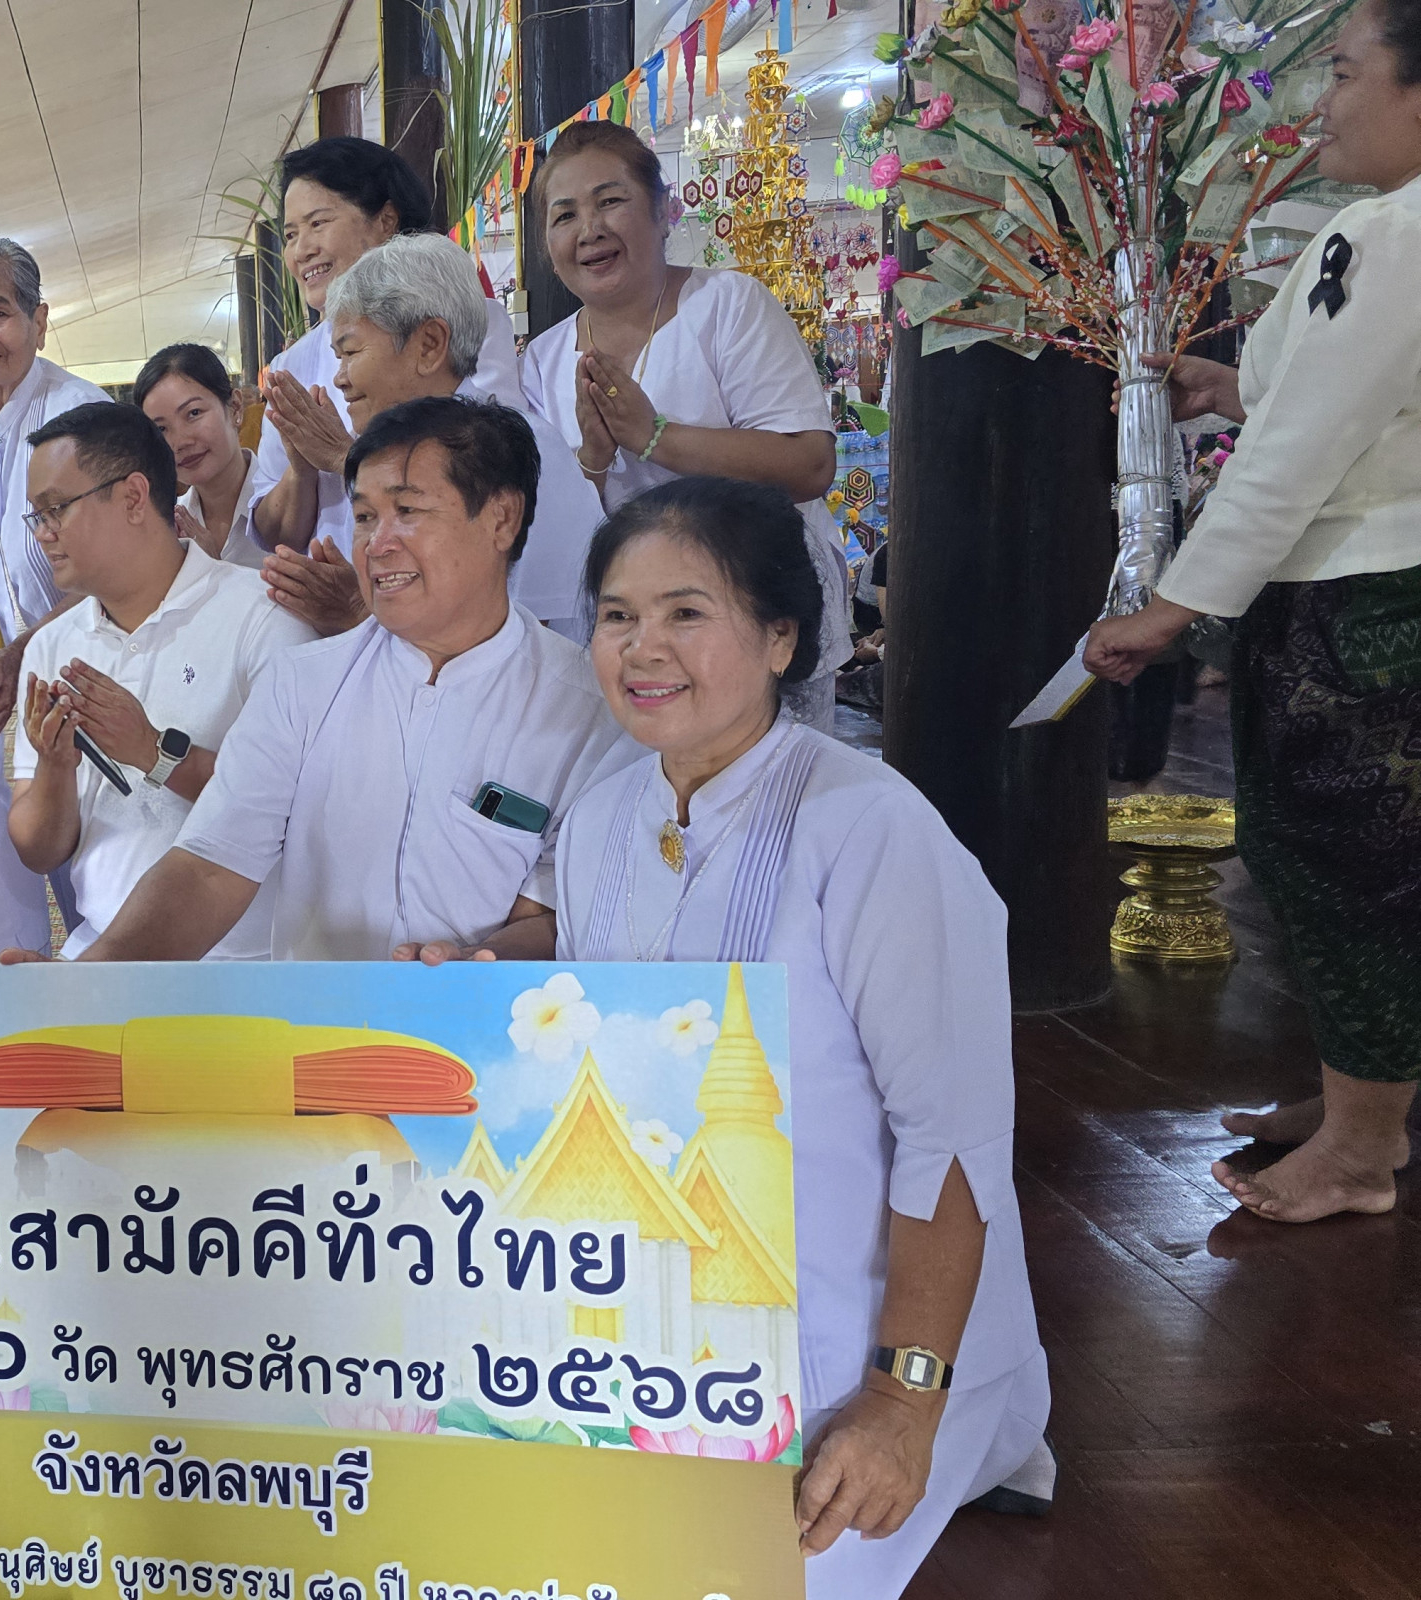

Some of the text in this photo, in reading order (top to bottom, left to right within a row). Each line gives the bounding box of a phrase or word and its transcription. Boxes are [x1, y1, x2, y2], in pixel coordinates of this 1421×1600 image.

[52, 1325, 116, 1383] วัด
[137, 1334, 444, 1408] พุทธศักราช
[472, 1344, 762, 1425] ๒๕๖๘
[37, 1434, 368, 1531] จังหวัดลพบุรี
[116, 1561, 289, 1600] บูชาธรรม
[380, 1568, 404, 1600] ปี
